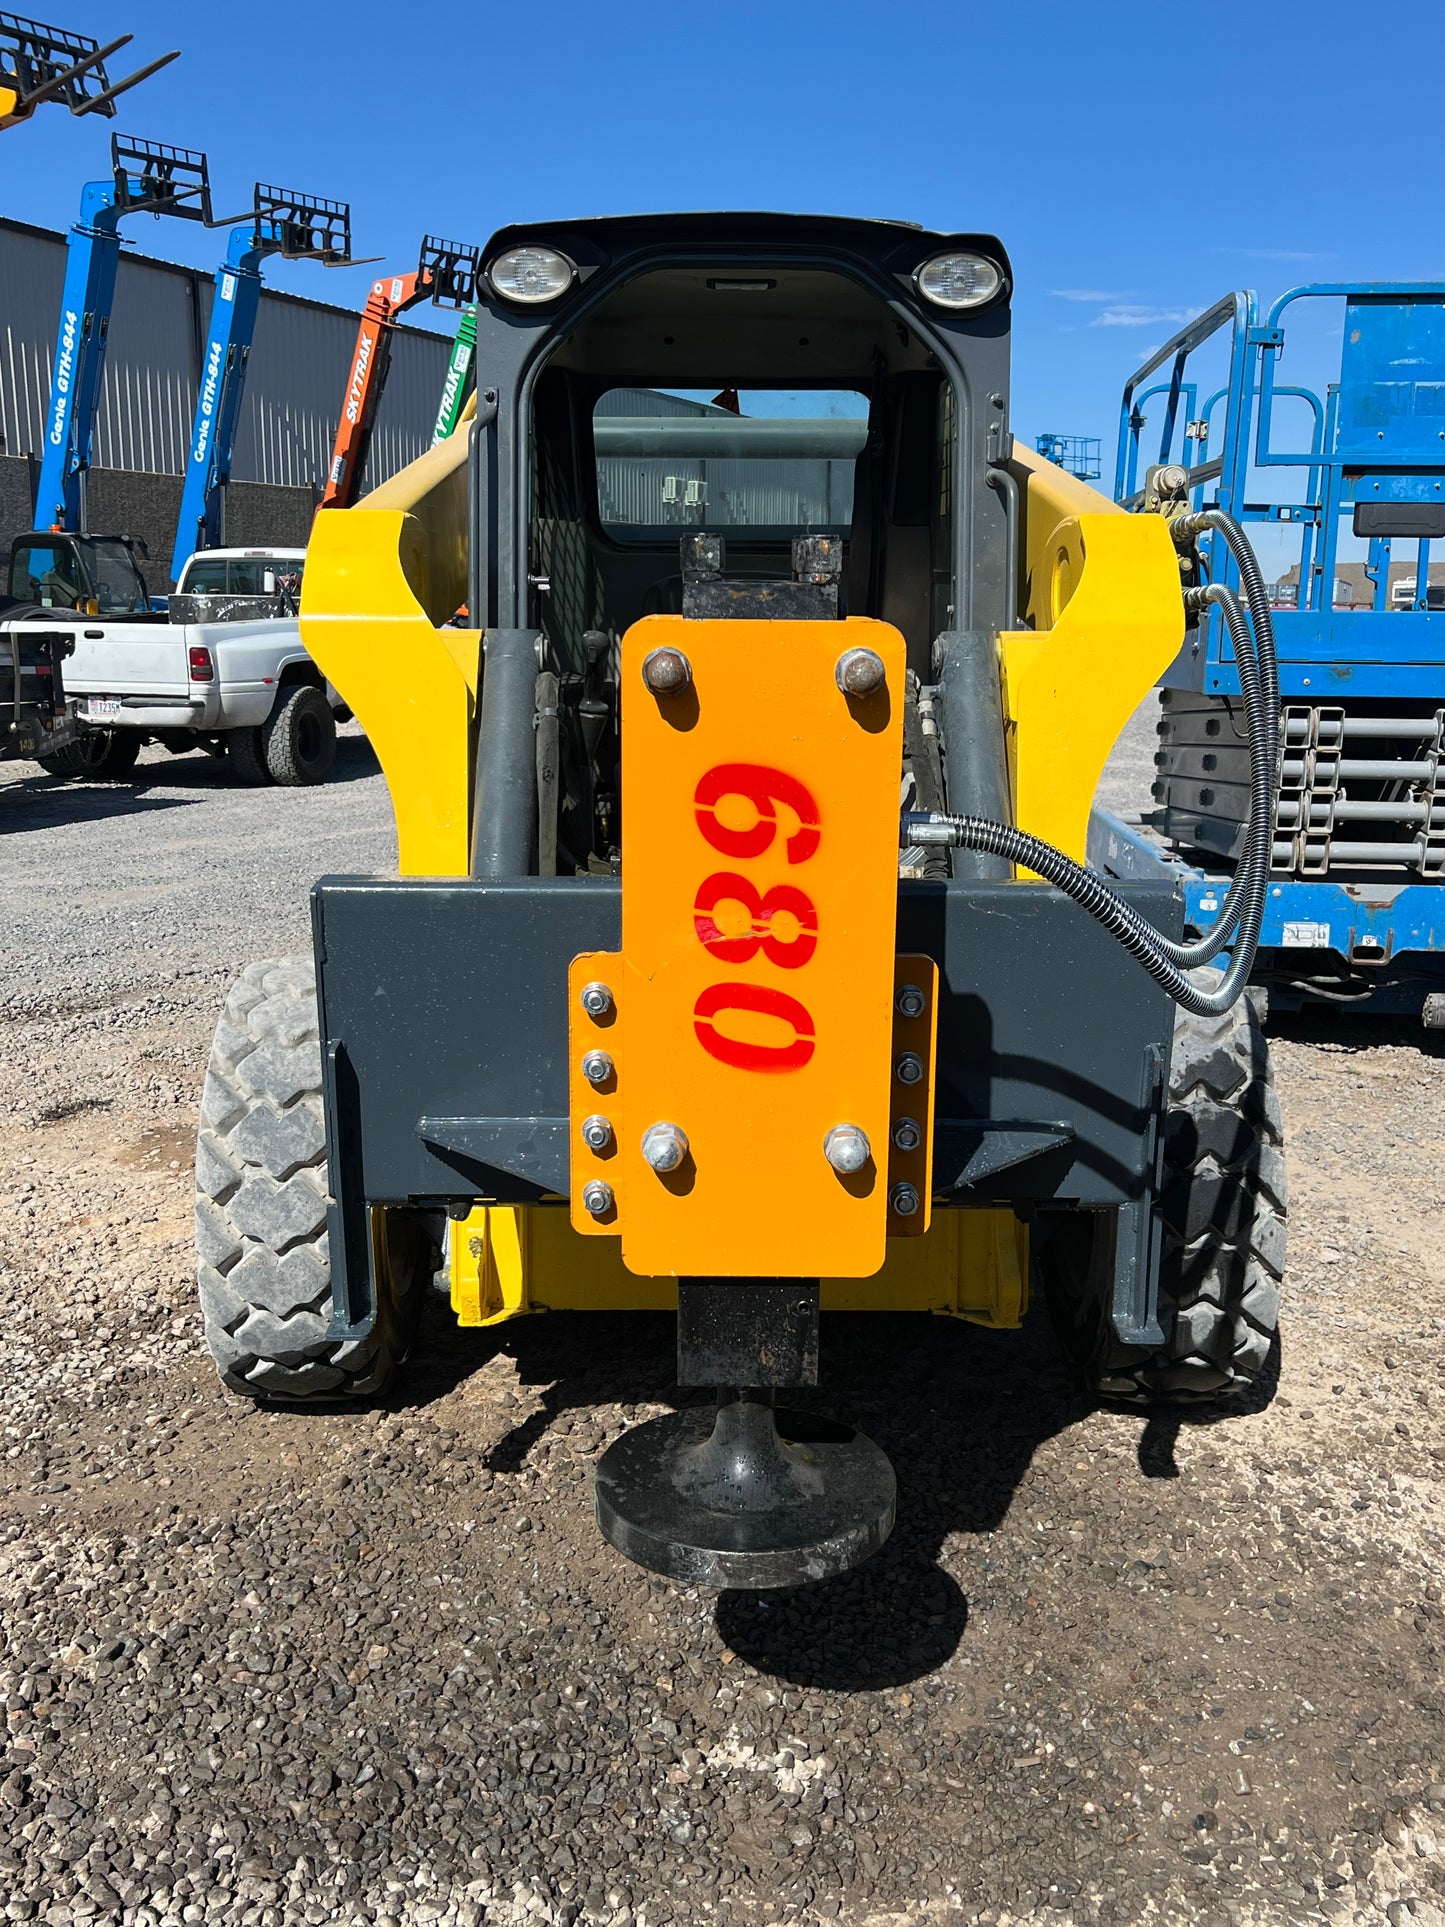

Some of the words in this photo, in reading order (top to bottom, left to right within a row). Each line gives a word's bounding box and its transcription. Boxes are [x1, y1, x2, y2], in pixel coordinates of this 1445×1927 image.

[57, 310, 78, 393] GTH-844
[202, 341, 223, 416] GTH-844
[346, 332, 373, 424] SKYTRAK
[50, 397, 67, 445] Genie
[194, 419, 211, 463] Genie
[430, 365, 461, 450] KYTRAK
[693, 763, 821, 1074] 680
